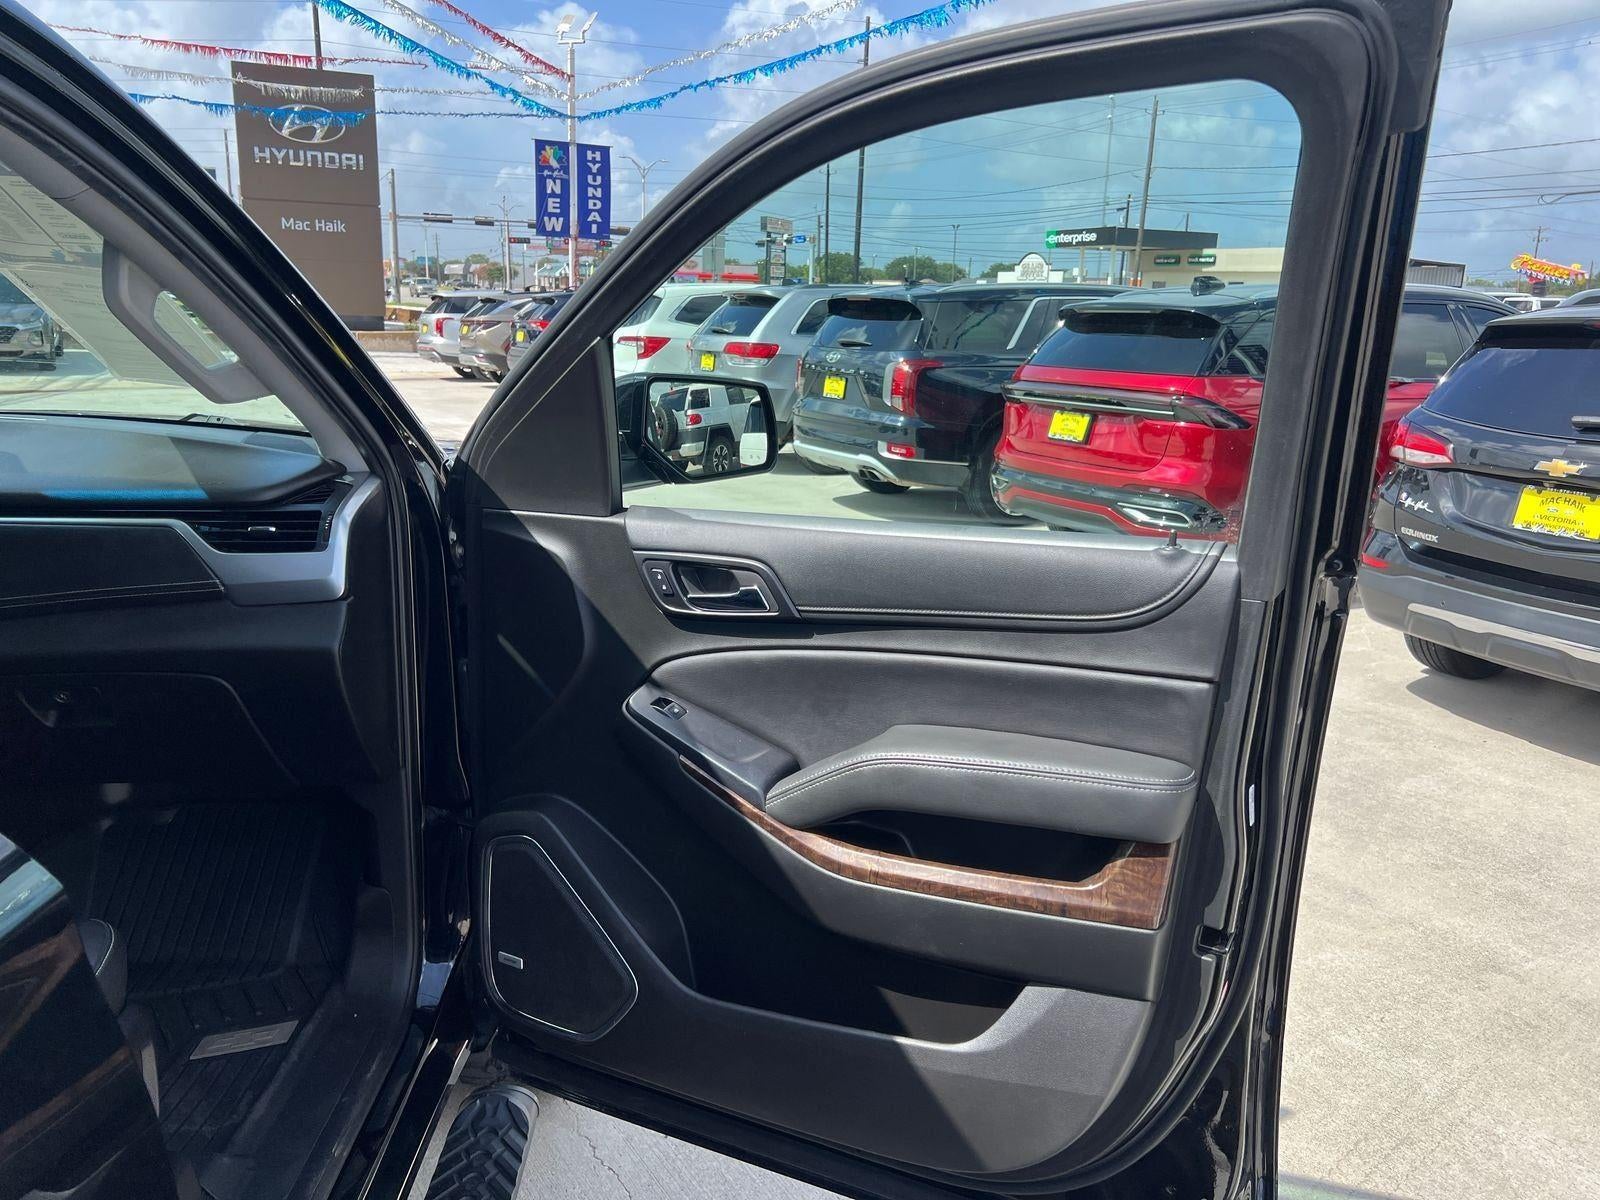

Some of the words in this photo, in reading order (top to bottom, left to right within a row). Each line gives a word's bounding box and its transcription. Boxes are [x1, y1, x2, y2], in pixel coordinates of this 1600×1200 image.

[253, 145, 365, 171] HYUNDAI
[586, 150, 603, 234] HYUNDAI
[543, 178, 564, 232] NEW
[281, 217, 311, 231] Mac
[315, 219, 347, 233] Haik
[1046, 230, 1098, 246] enterprise
[1539, 496, 1562, 507] MAC
[1563, 496, 1587, 513] HAIK
[1539, 514, 1577, 526] VICTORIA
[1400, 526, 1439, 543] EQUINOX
